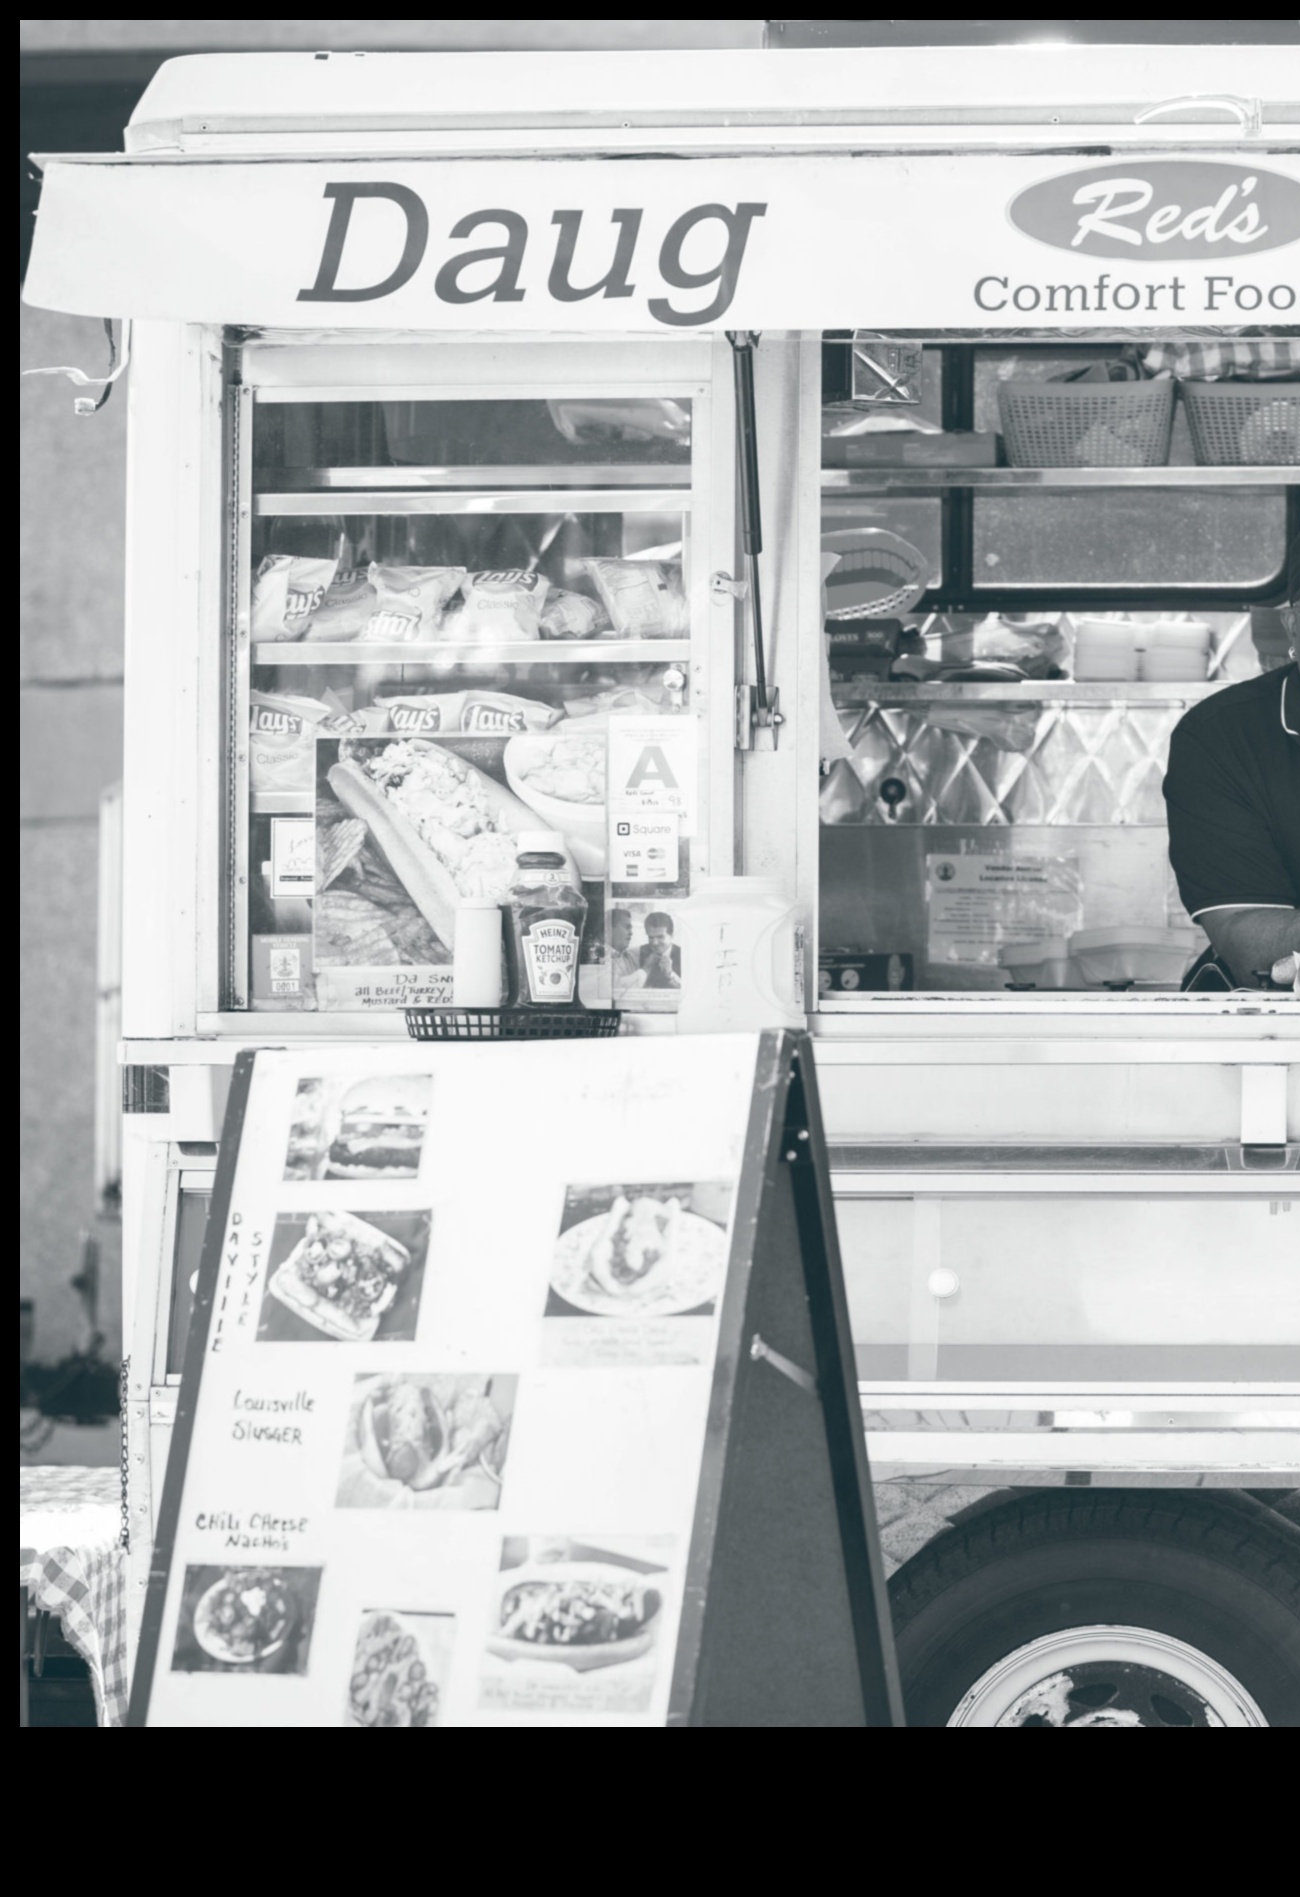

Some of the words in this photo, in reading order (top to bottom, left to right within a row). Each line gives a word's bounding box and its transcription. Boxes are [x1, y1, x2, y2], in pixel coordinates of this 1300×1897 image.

[1070, 175, 1269, 247] Red's
[295, 181, 768, 327] Daug
[973, 274, 1186, 312] Comfort
[624, 745, 679, 789] A
[633, 824, 672, 836] Square
[623, 849, 642, 858] VISA
[540, 927, 568, 939] HEINZ
[533, 943, 573, 955] TOMATO
[535, 955, 571, 963] KETCHUP
